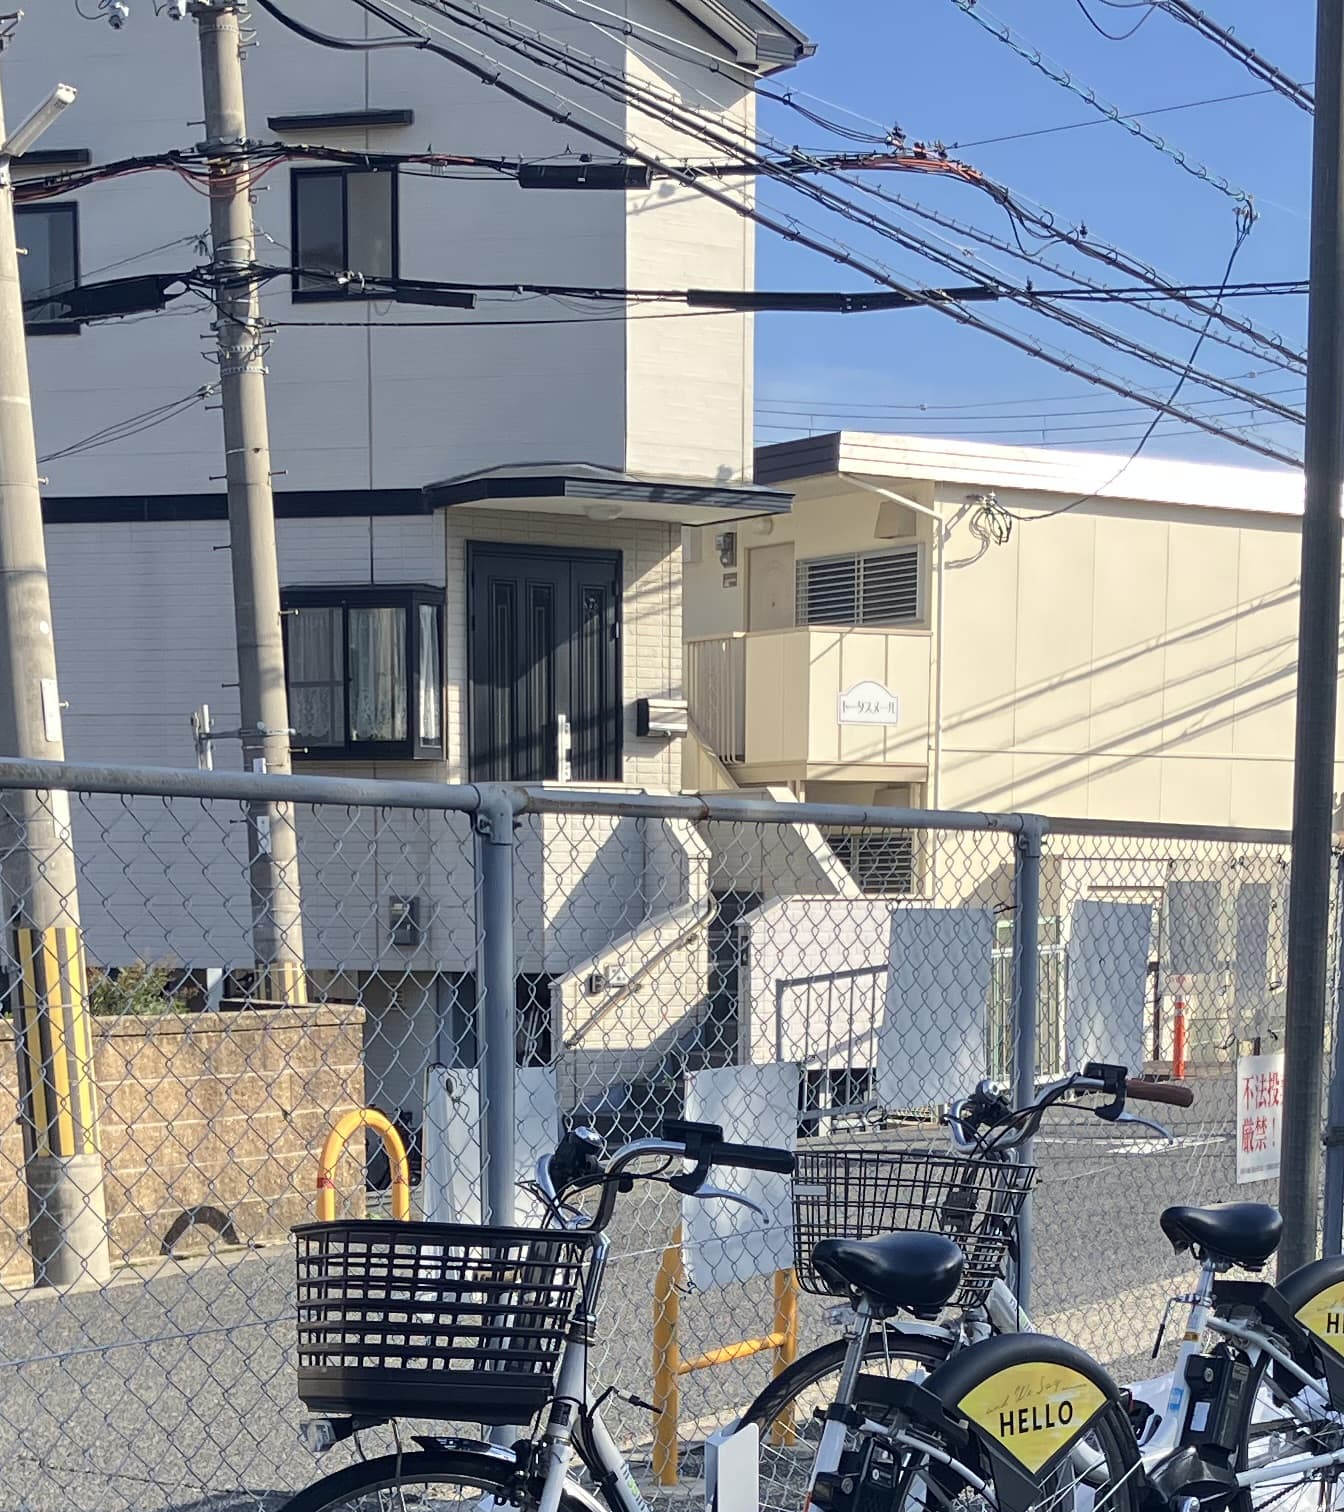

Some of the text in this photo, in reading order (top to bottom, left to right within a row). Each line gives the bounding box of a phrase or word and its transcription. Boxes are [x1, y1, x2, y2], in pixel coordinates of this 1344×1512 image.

[1242, 1072, 1284, 1111] 不法投
[999, 1400, 1073, 1438] HELLO
